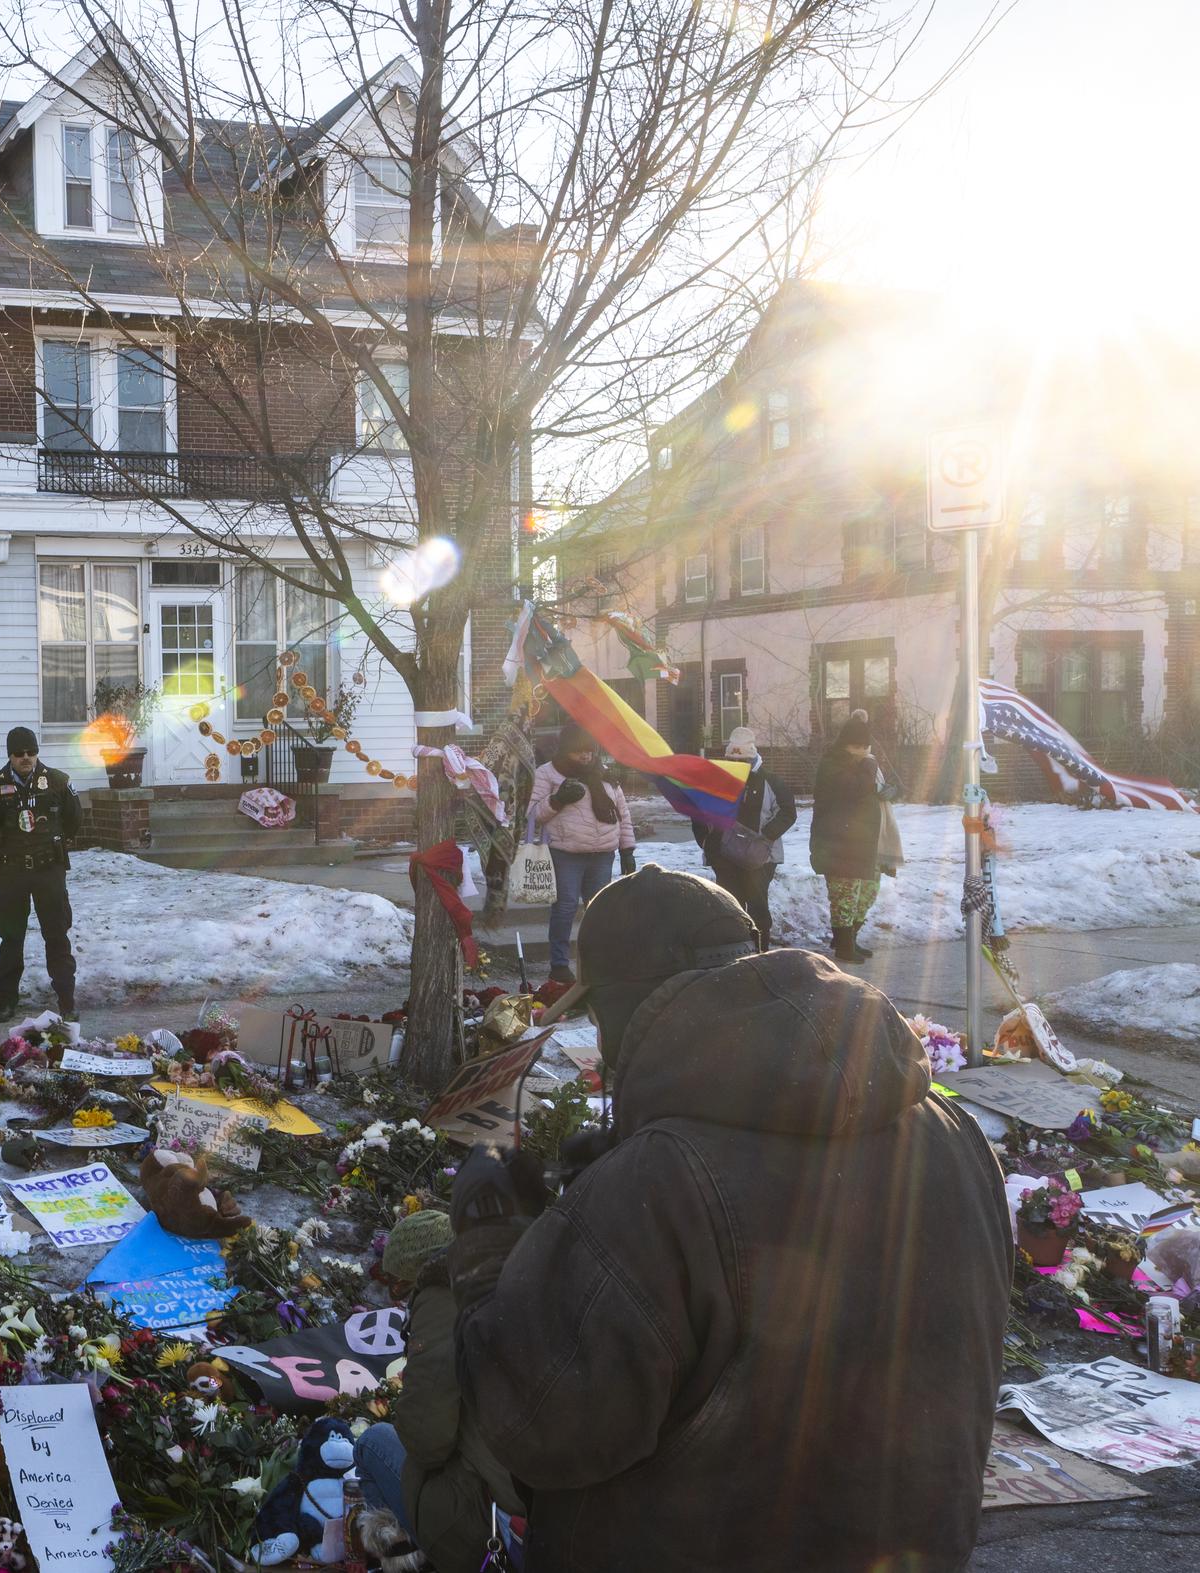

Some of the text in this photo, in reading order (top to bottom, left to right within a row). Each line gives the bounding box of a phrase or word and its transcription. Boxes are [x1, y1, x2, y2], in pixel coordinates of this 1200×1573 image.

[6, 1168, 108, 1192] MARTYRED
[4, 1408, 64, 1424] Displaced
[31, 1436, 51, 1456] by
[19, 1468, 72, 1484] America
[27, 1495, 74, 1509] Denied
[54, 1519, 71, 1531] by
